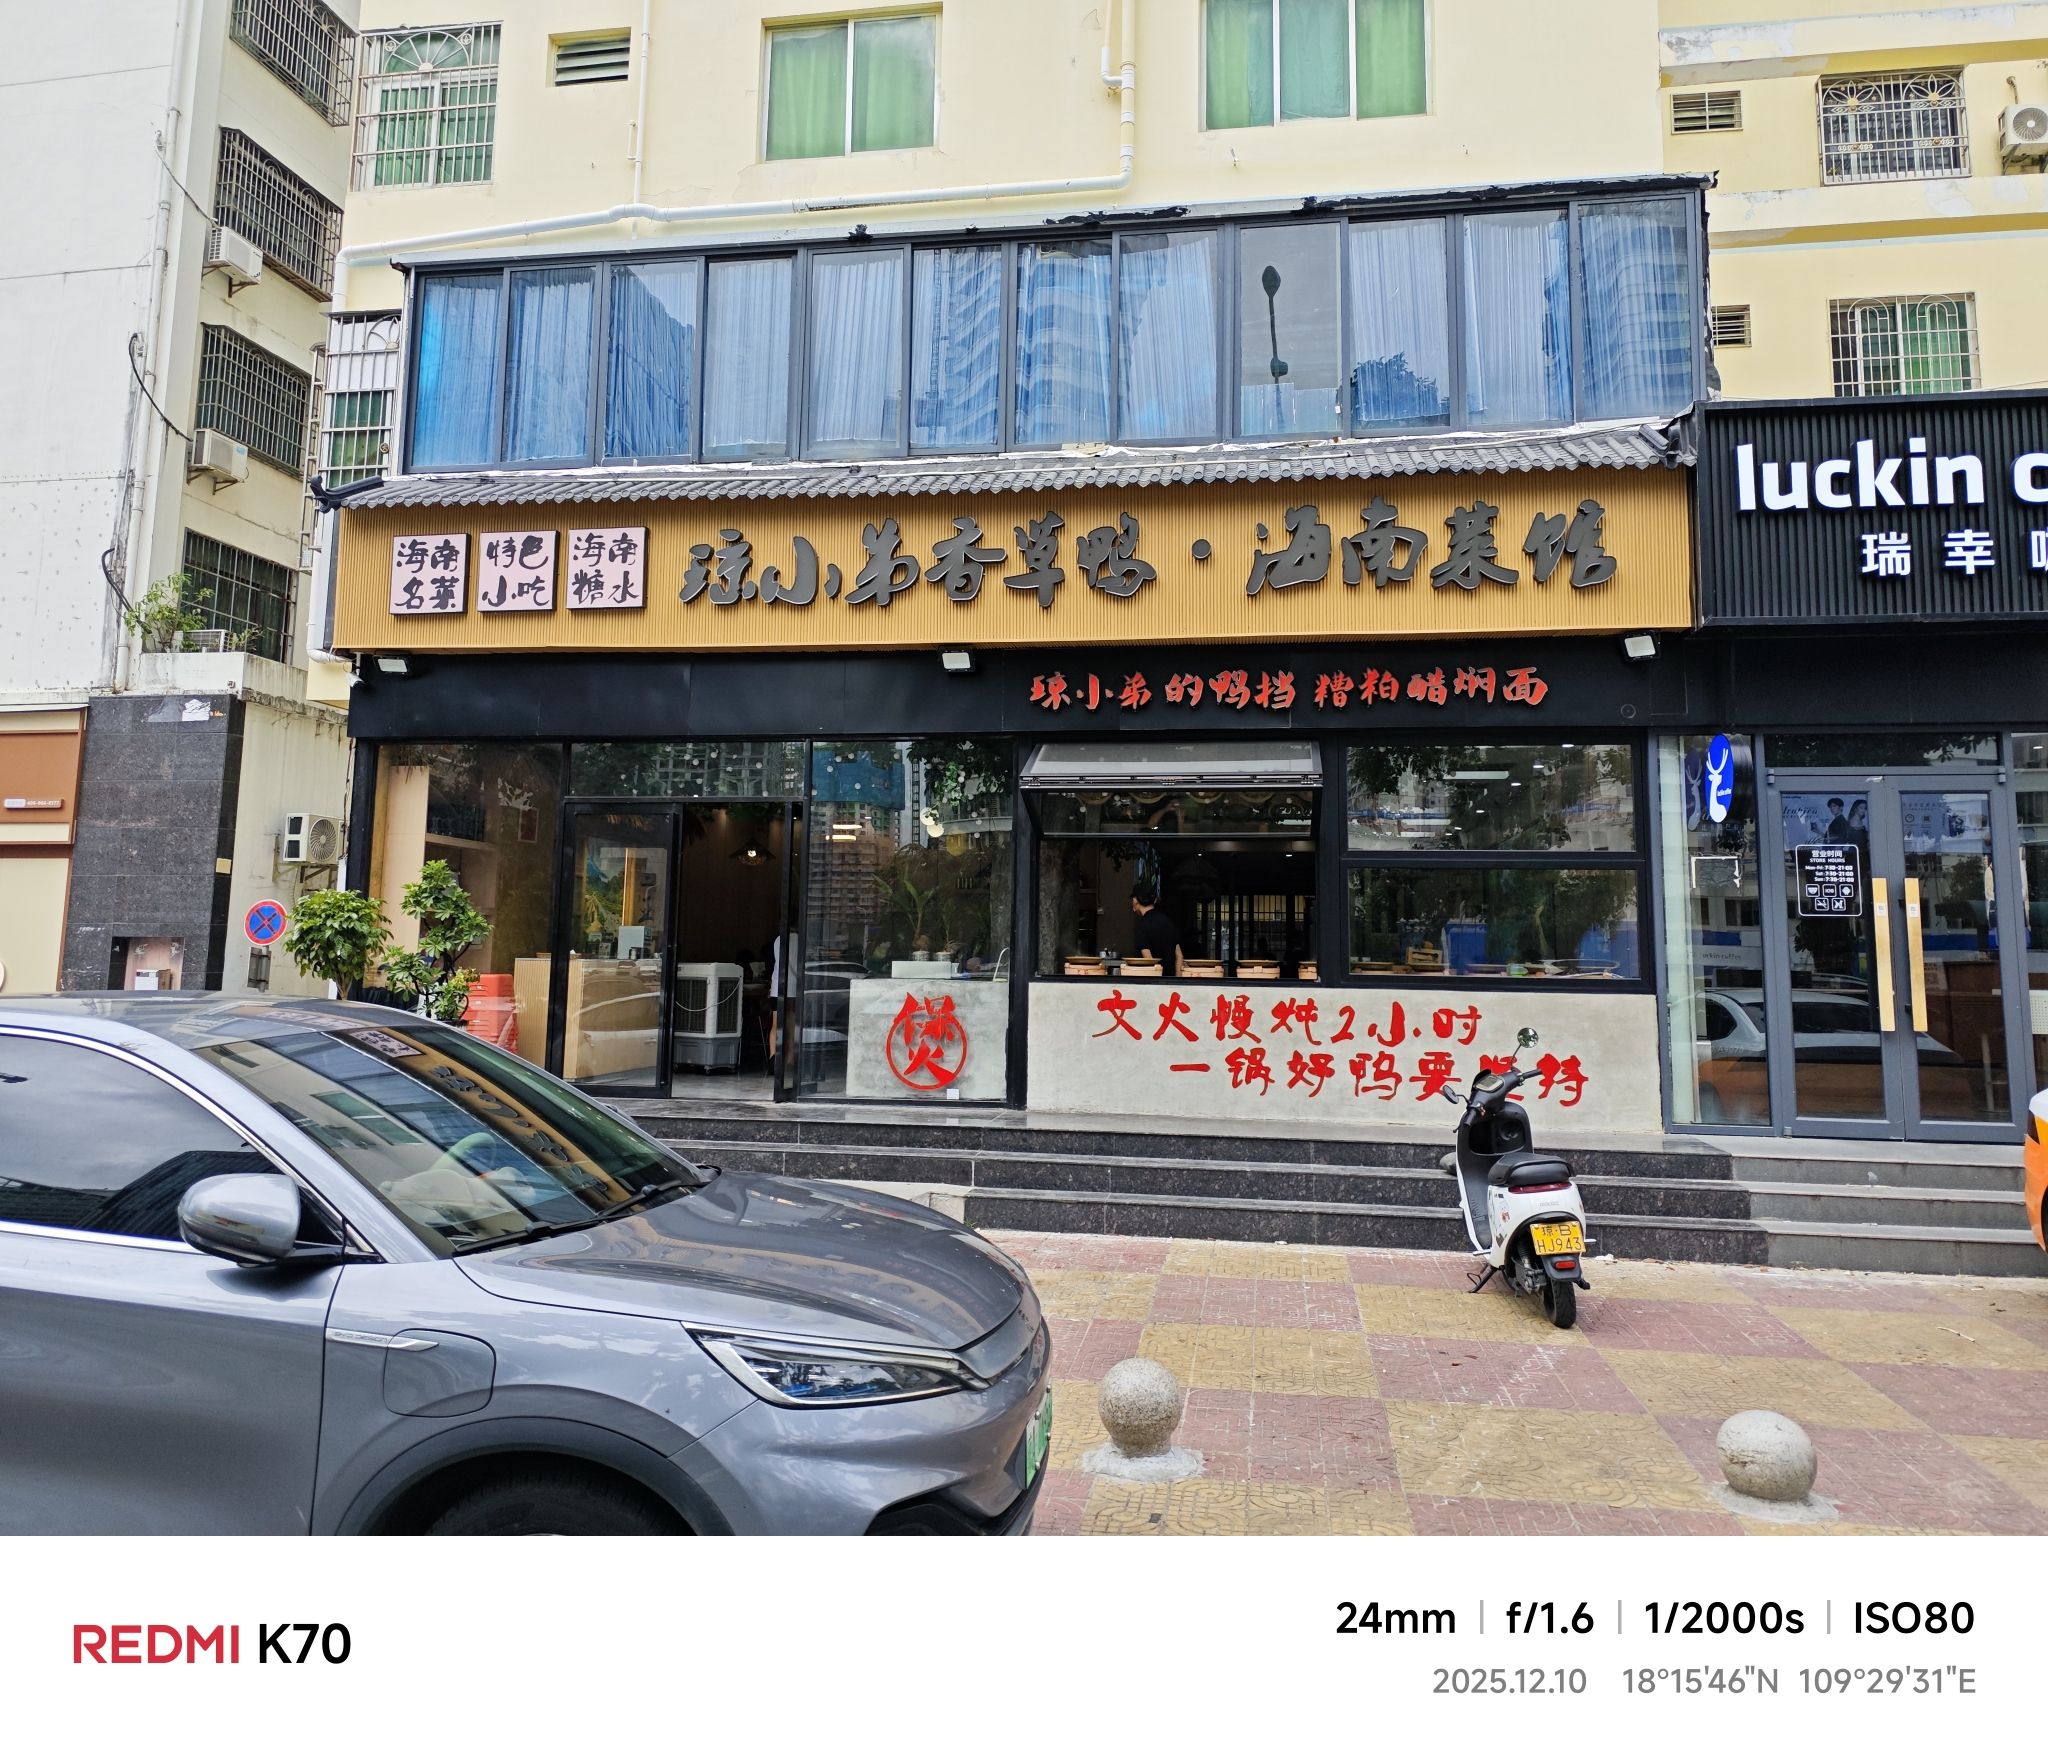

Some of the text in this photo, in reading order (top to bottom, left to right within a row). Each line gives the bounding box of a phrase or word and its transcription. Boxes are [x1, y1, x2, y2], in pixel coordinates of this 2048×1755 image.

[1737, 437, 1985, 511] luckin
[397, 538, 460, 574] 海南
[486, 535, 549, 570] 特色
[573, 532, 638, 567] 海南
[394, 575, 460, 610] 名菜
[481, 574, 550, 607] 小吃
[571, 569, 640, 605] 糖水
[1091, 989, 1482, 1049] 文火慢炖2小时
[1537, 1237, 1582, 1253] HJ943
